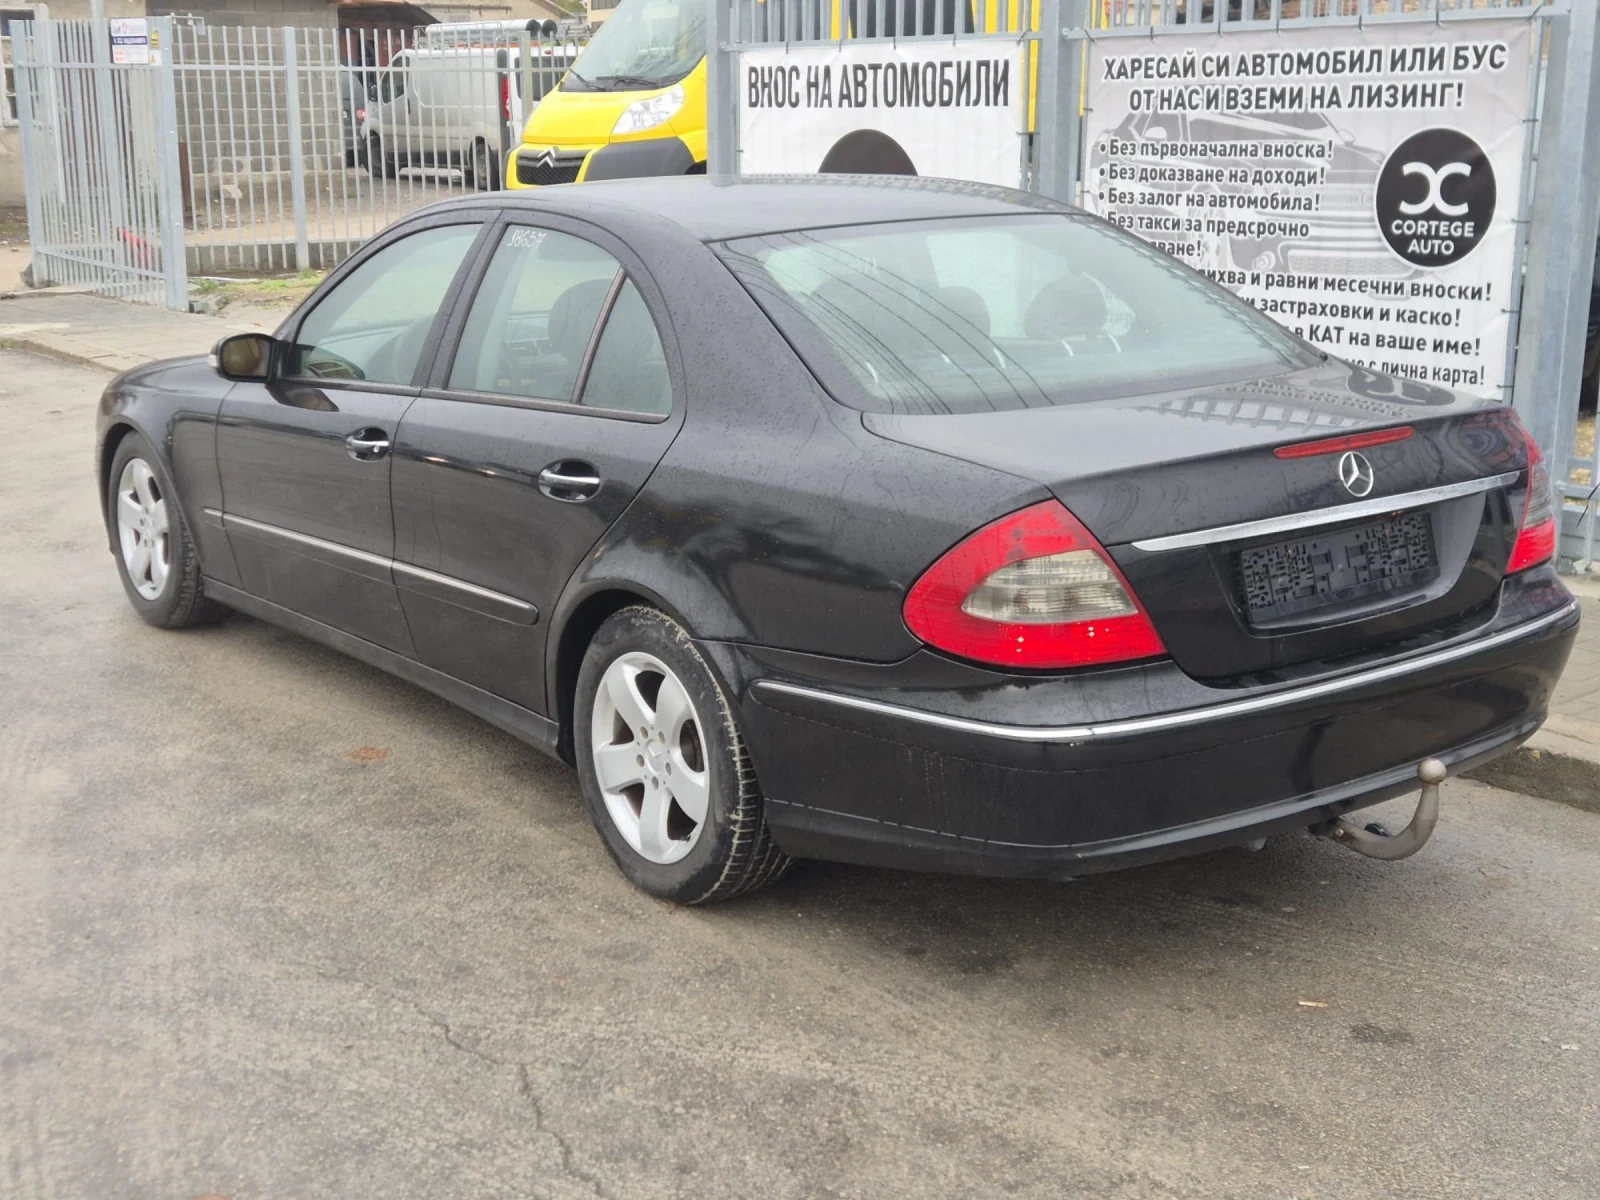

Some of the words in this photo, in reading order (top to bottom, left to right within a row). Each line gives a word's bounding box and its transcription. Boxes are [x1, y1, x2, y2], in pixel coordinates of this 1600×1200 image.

[1103, 50, 1196, 80] ХАРЕСАЙ
[1202, 55, 1229, 78] СИ
[1236, 49, 1382, 77] АВТОМОБИЛ
[1390, 46, 1445, 73] ИЛИ
[1453, 44, 1506, 71] БУС
[748, 65, 800, 108] ВНОС
[806, 65, 832, 108] НА
[838, 59, 1009, 108] АВТОМОБИЛИ
[1129, 89, 1155, 111] ОТ
[1160, 87, 1200, 111] НАС
[1206, 88, 1219, 110] И
[1226, 86, 1304, 110] ВЗЕМИ
[1310, 85, 1342, 109] НА
[1348, 82, 1463, 108] ЛИЗИНГ!
[1110, 138, 1136, 156] Без
[1140, 142, 1258, 160] първоначална
[1263, 139, 1333, 159] вноска!
[1109, 163, 1135, 180] Без
[1139, 166, 1224, 183] доказване
[1229, 168, 1248, 183] на
[1252, 167, 1325, 187] доходи!
[1108, 188, 1134, 204] Без
[1138, 190, 1182, 206] залог
[1186, 192, 1205, 207] на
[1208, 191, 1320, 211] автомобила!
[1108, 211, 1134, 229] Без
[1138, 216, 1180, 231] такси
[1185, 218, 1202, 232] за
[1206, 219, 1310, 241] предсрочно
[1391, 219, 1475, 237] CORTEGE
[1407, 239, 1455, 255] AUTO
[1251, 272, 1260, 286] и
[1265, 273, 1319, 291] равни
[1323, 276, 1405, 295] месечни
[1410, 282, 1492, 301] вноски!
[1260, 298, 1374, 321] застраховки
[1379, 307, 1390, 322] и
[1396, 308, 1461, 327] каско!
[1309, 324, 1345, 344] КАТ
[1349, 331, 1370, 347] на
[1376, 333, 1427, 351] ваше
[1432, 337, 1481, 356] име!
[1432, 366, 1485, 388] карта!
